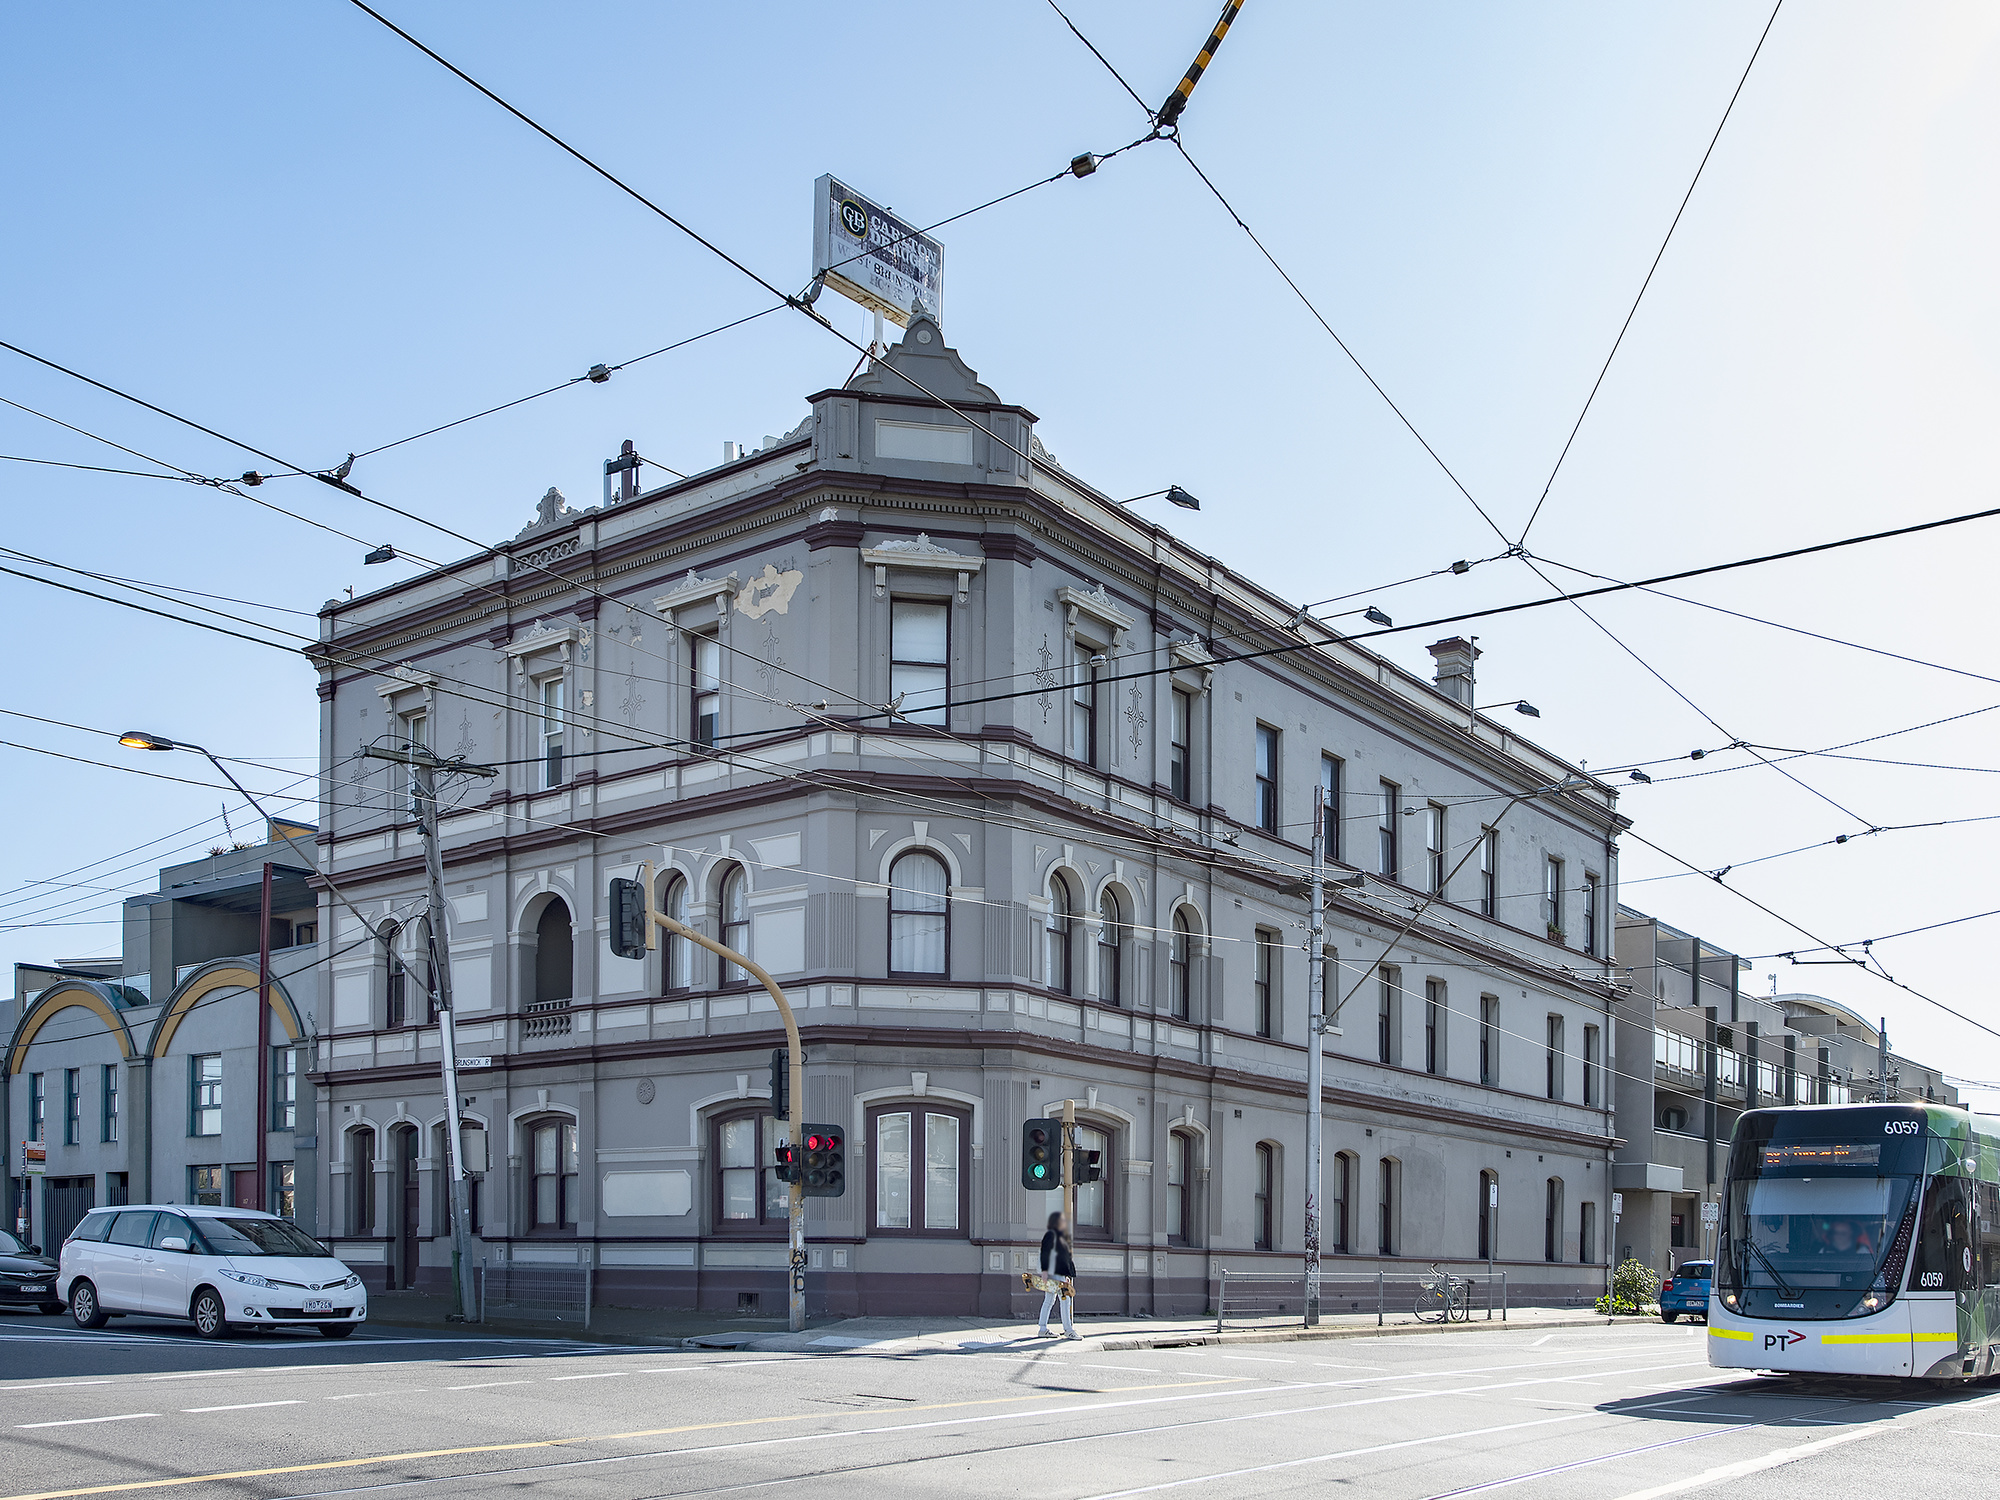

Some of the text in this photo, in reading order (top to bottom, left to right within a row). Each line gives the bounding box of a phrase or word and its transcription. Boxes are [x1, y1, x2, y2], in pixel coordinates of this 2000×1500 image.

[871, 215, 937, 264] CARLTON
[837, 244, 871, 268] WST
[1884, 1121, 1919, 1135] 6059
[1920, 1272, 1944, 1287] 6059
